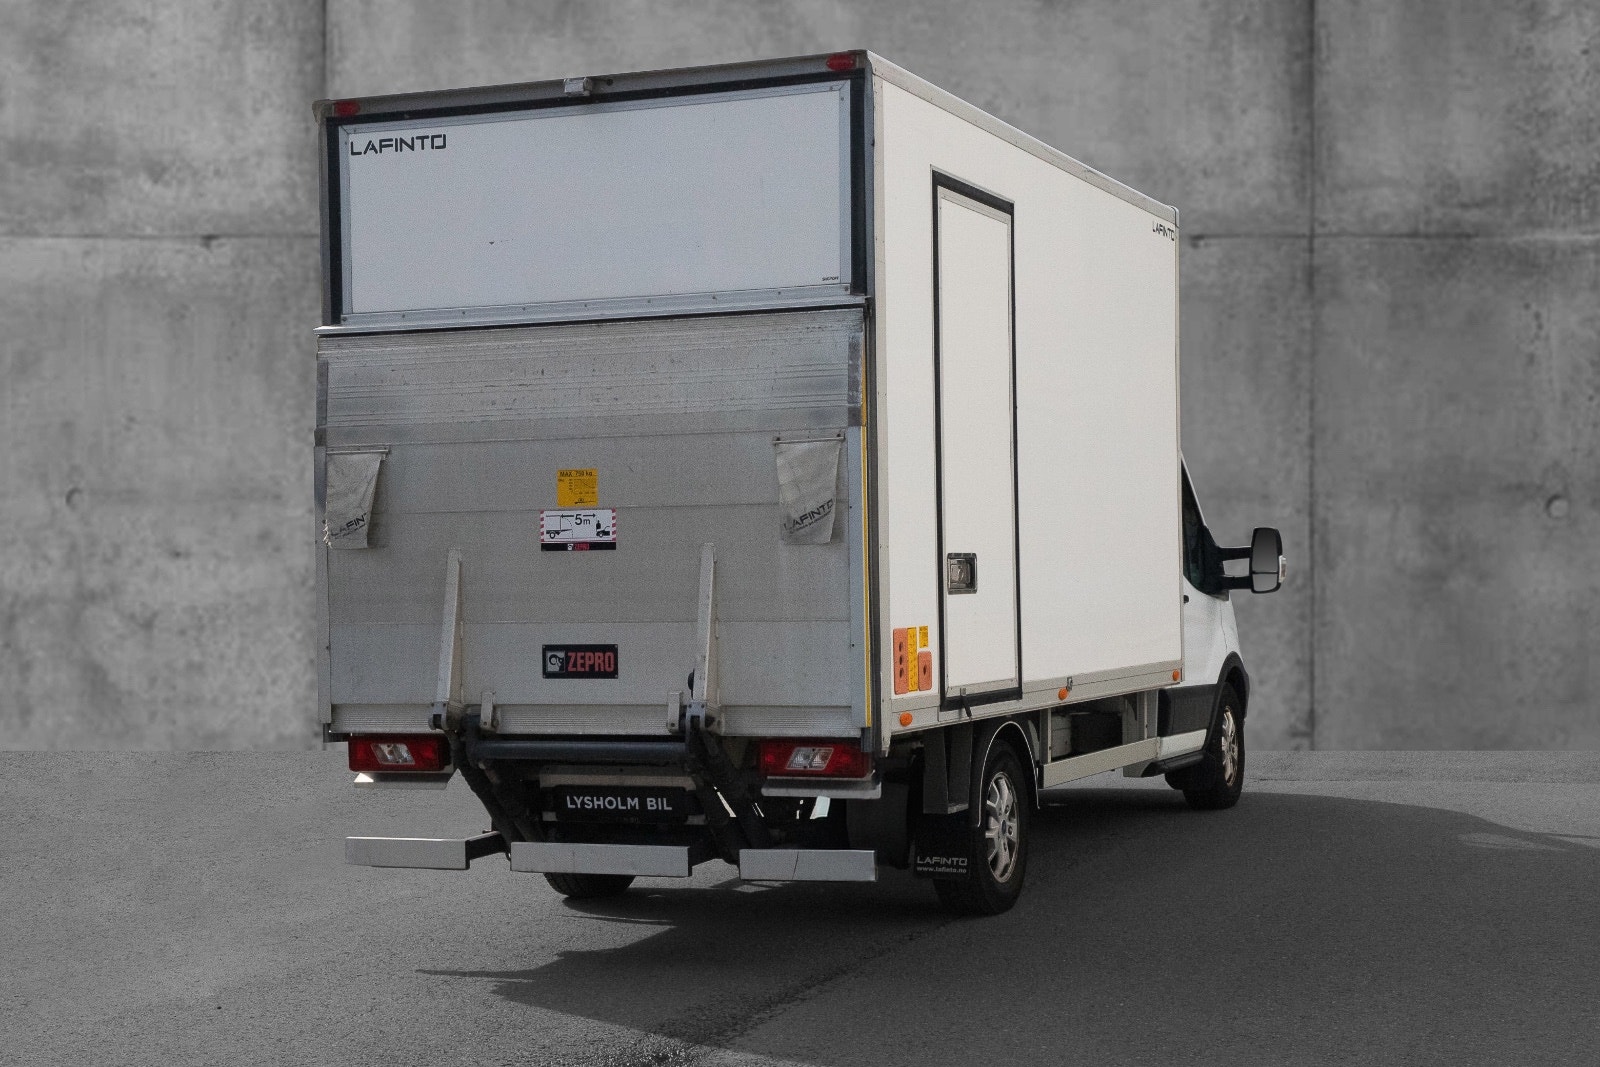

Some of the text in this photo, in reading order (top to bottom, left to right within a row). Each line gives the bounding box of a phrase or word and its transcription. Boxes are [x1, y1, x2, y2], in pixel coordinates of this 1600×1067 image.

[351, 134, 446, 155] LAFINTO
[784, 498, 834, 531] LAFINTO
[567, 652, 615, 672] ZEPRO
[566, 796, 673, 810] LYSHOLM BIL
[916, 856, 967, 866] LAFINTO
